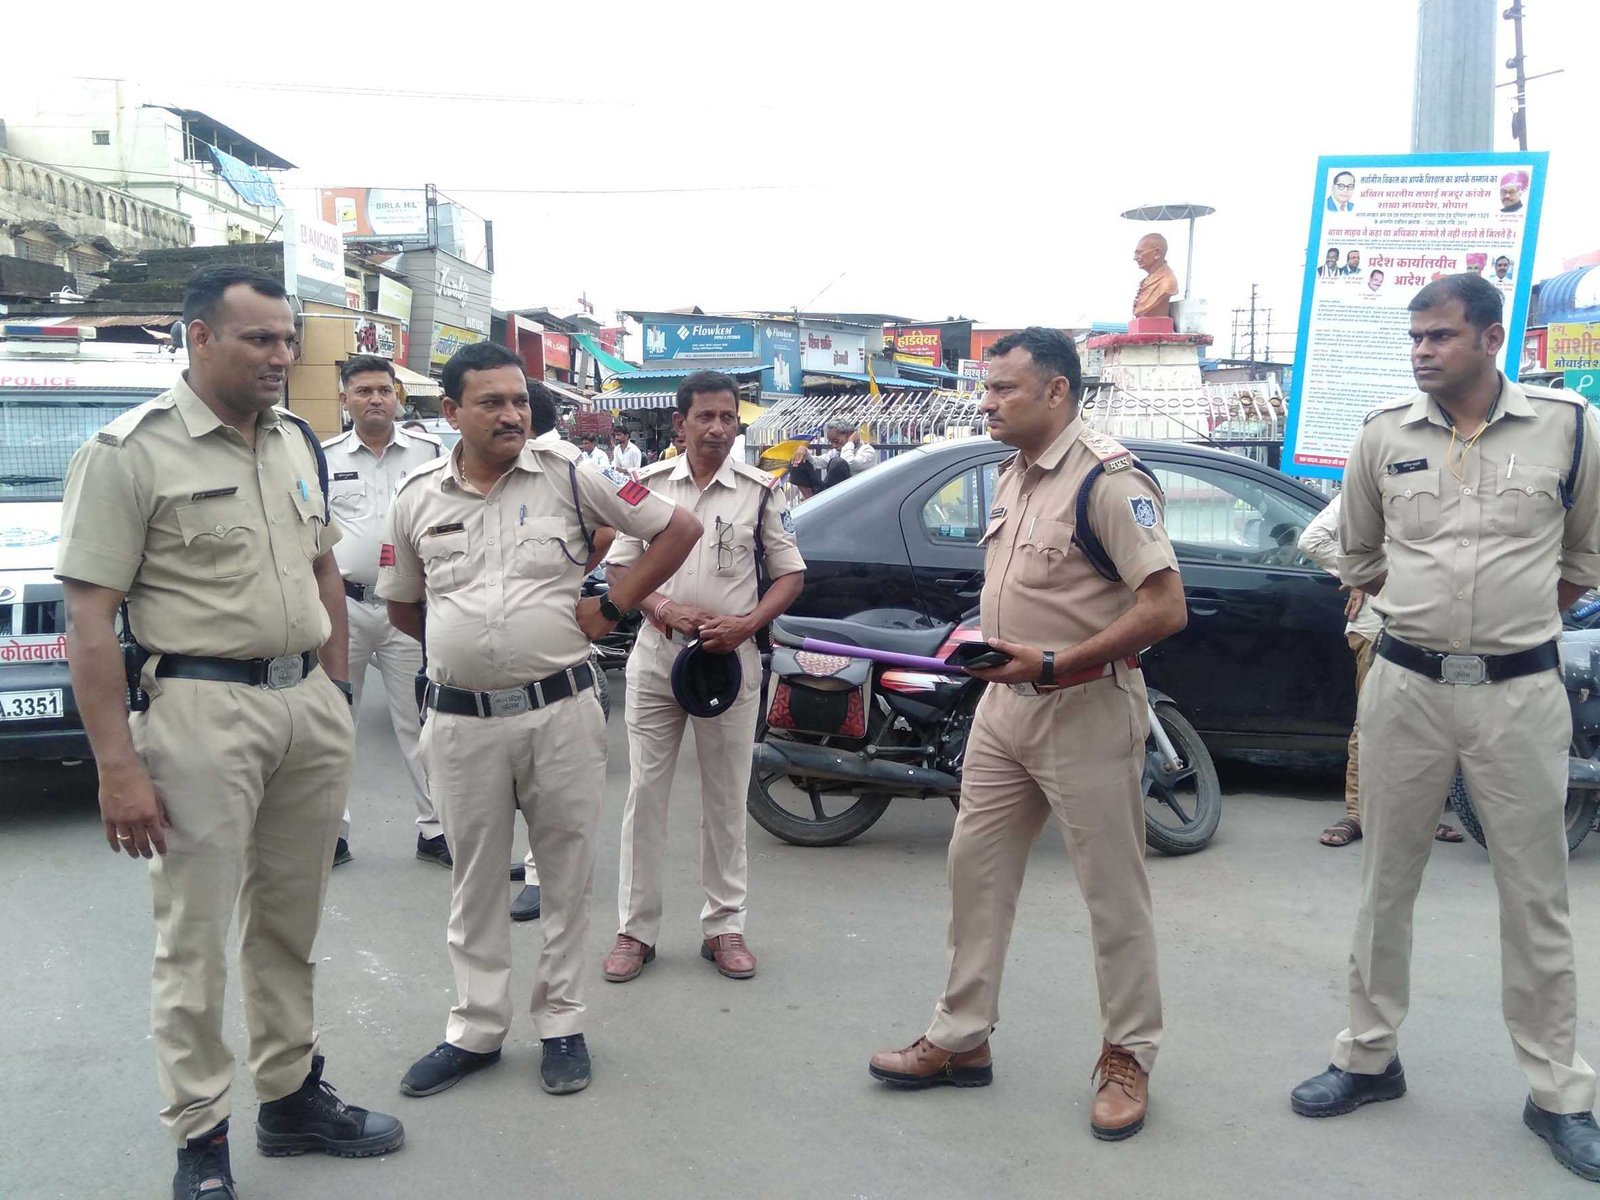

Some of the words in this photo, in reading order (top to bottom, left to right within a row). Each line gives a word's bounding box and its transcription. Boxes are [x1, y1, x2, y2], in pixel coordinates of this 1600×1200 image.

[1400, 175, 1408, 184] का
[1445, 175, 1453, 183] का
[1490, 175, 1498, 183] का
[1386, 188, 1414, 198] भारतीय
[1416, 188, 1440, 199] सफाई
[376, 202, 400, 210] BIRLA
[1442, 199, 1469, 210] भोपाल
[1368, 228, 1382, 238] कहा
[309, 228, 339, 255] ANCHOR
[1368, 253, 1395, 268] प्रदेश
[1396, 254, 1457, 270] कार्यालयीन
[1394, 271, 1426, 287] आदेश
[898, 330, 938, 349] हार्डवेयर
[1, 376, 77, 386] POLICE
[0, 636, 67, 662] कोतवाली
